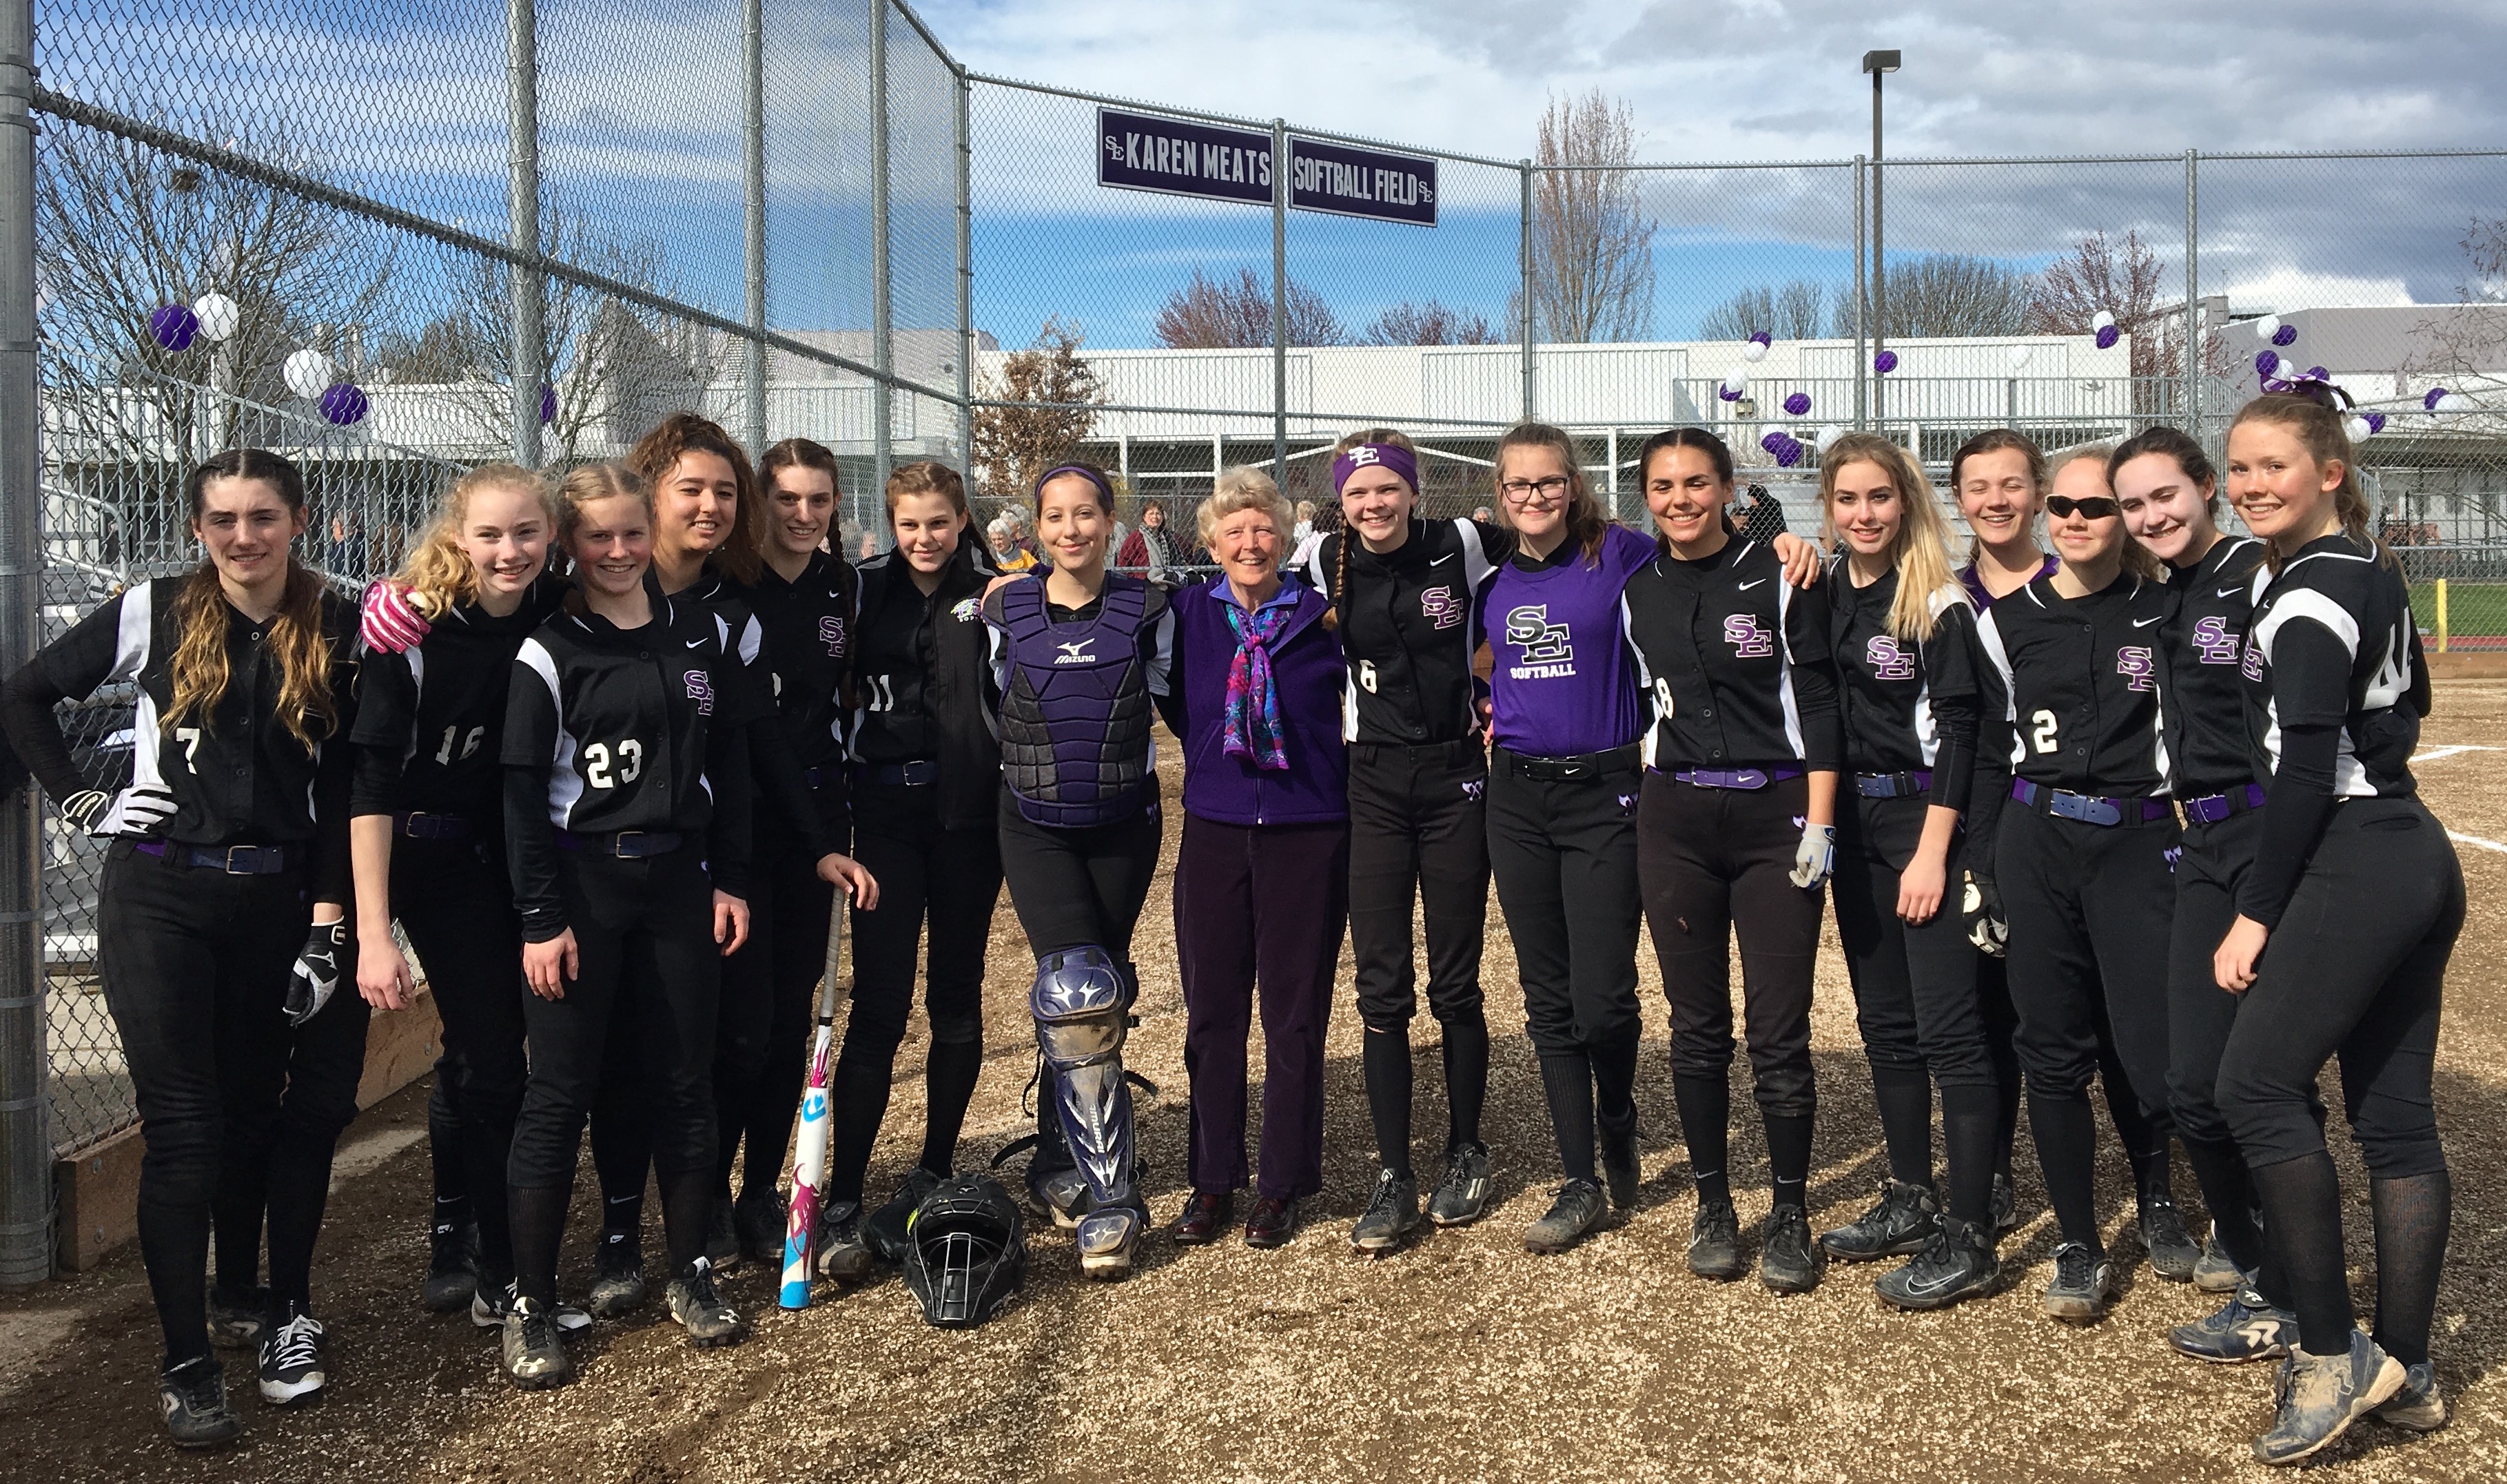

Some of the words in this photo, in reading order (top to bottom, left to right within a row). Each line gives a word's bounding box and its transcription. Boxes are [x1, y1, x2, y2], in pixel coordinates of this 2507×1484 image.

[1126, 132, 1197, 177] KAREN
[1203, 143, 1271, 186] MEATS
[1294, 156, 1372, 200] SOFTBALL
[1375, 168, 1418, 205] FIELD
[1421, 585, 1464, 630] SE
[1506, 604, 1573, 665] SE
[1724, 614, 1773, 658] SE
[2192, 616, 2240, 664] SE
[1054, 655, 1096, 664] MIZUNO
[1359, 659, 1378, 694] 6
[1510, 663, 1576, 679] SOFTBALL
[1867, 635, 1915, 680] SE
[867, 674, 894, 712] 11
[1656, 677, 1675, 720] 8
[176, 727, 201, 775] 7
[435, 725, 485, 766] 16
[2032, 709, 2058, 754] 2
[584, 739, 642, 788] 23
